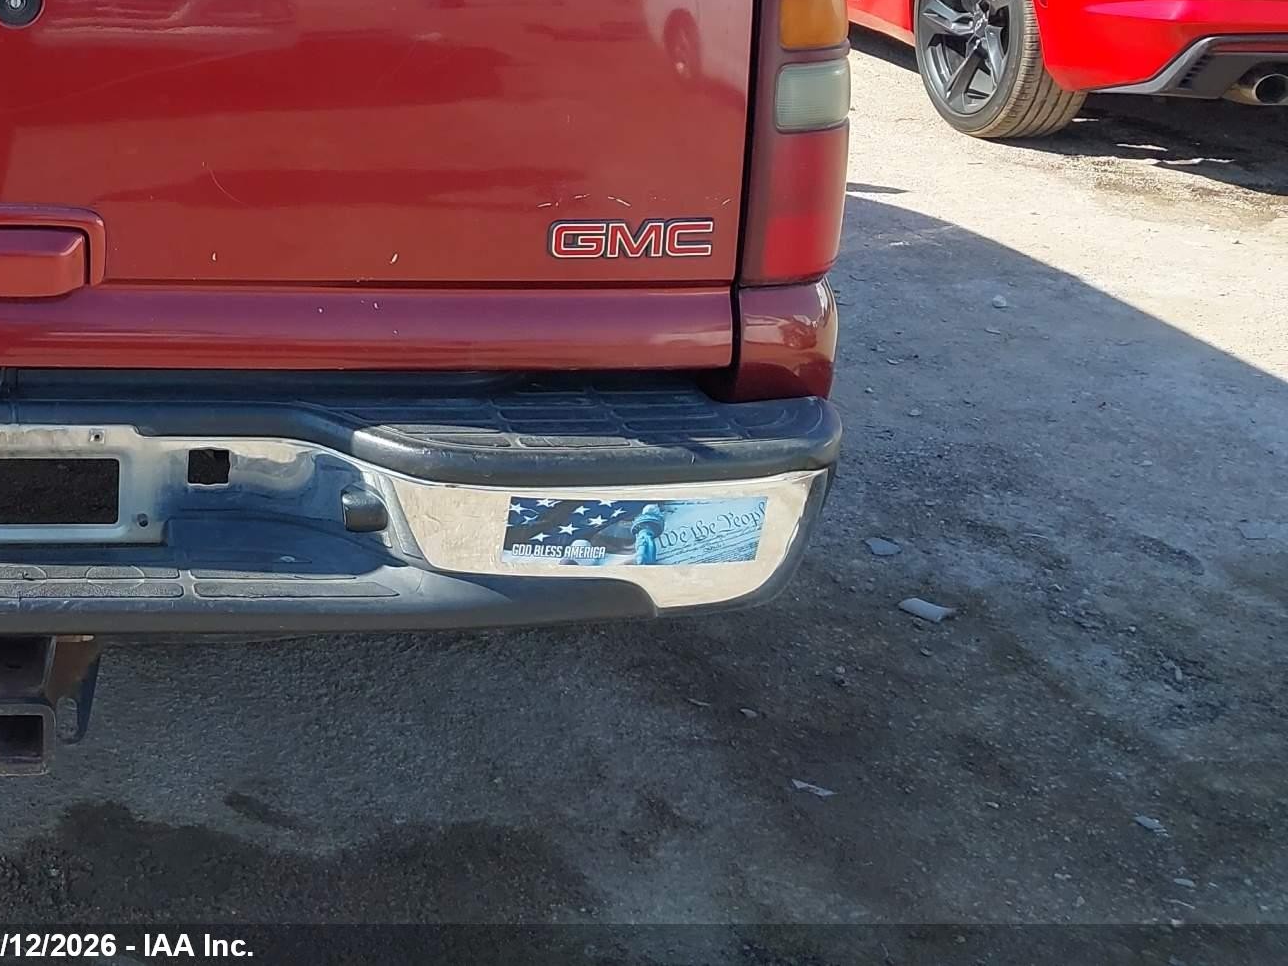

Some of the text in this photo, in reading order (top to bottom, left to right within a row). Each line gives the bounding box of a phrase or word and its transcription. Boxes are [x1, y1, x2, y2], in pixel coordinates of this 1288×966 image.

[550, 219, 714, 258] GMC
[657, 525, 689, 549] We
[691, 520, 716, 542] the
[512, 543, 607, 560] GOD BLESS AMERICA
